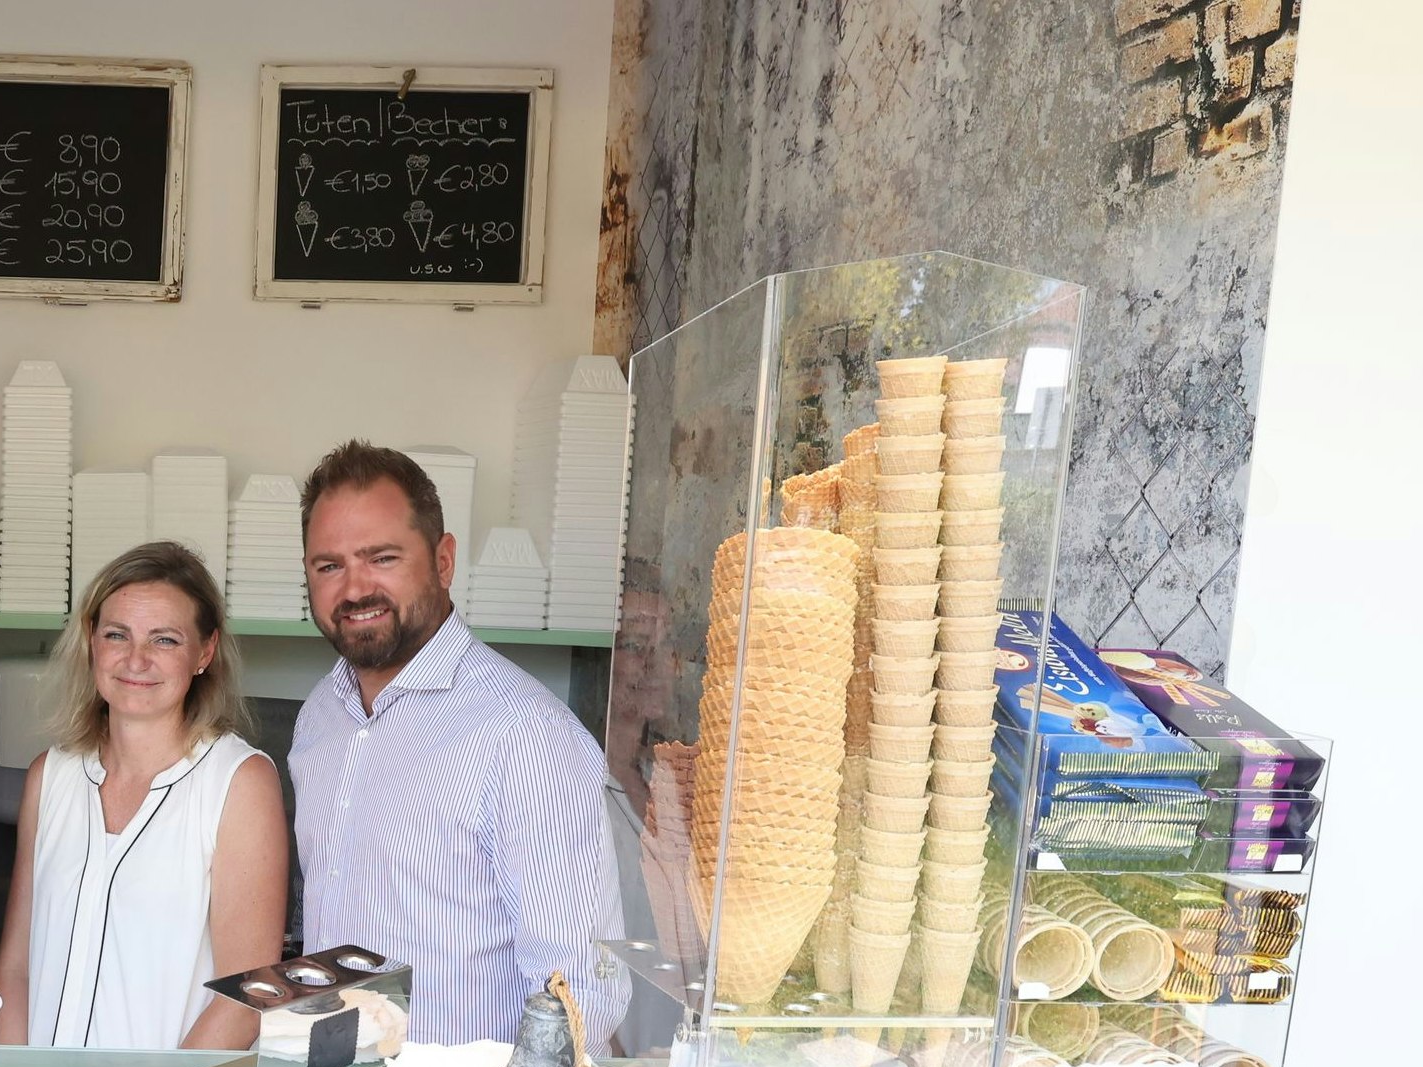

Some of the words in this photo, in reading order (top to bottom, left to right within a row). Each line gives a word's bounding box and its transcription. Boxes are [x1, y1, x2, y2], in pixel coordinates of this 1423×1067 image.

[57, 134, 121, 168] 8,90
[43, 169, 123, 200] 15,90
[41, 203, 125, 231] 20,90
[44, 238, 134, 267] 25,90
